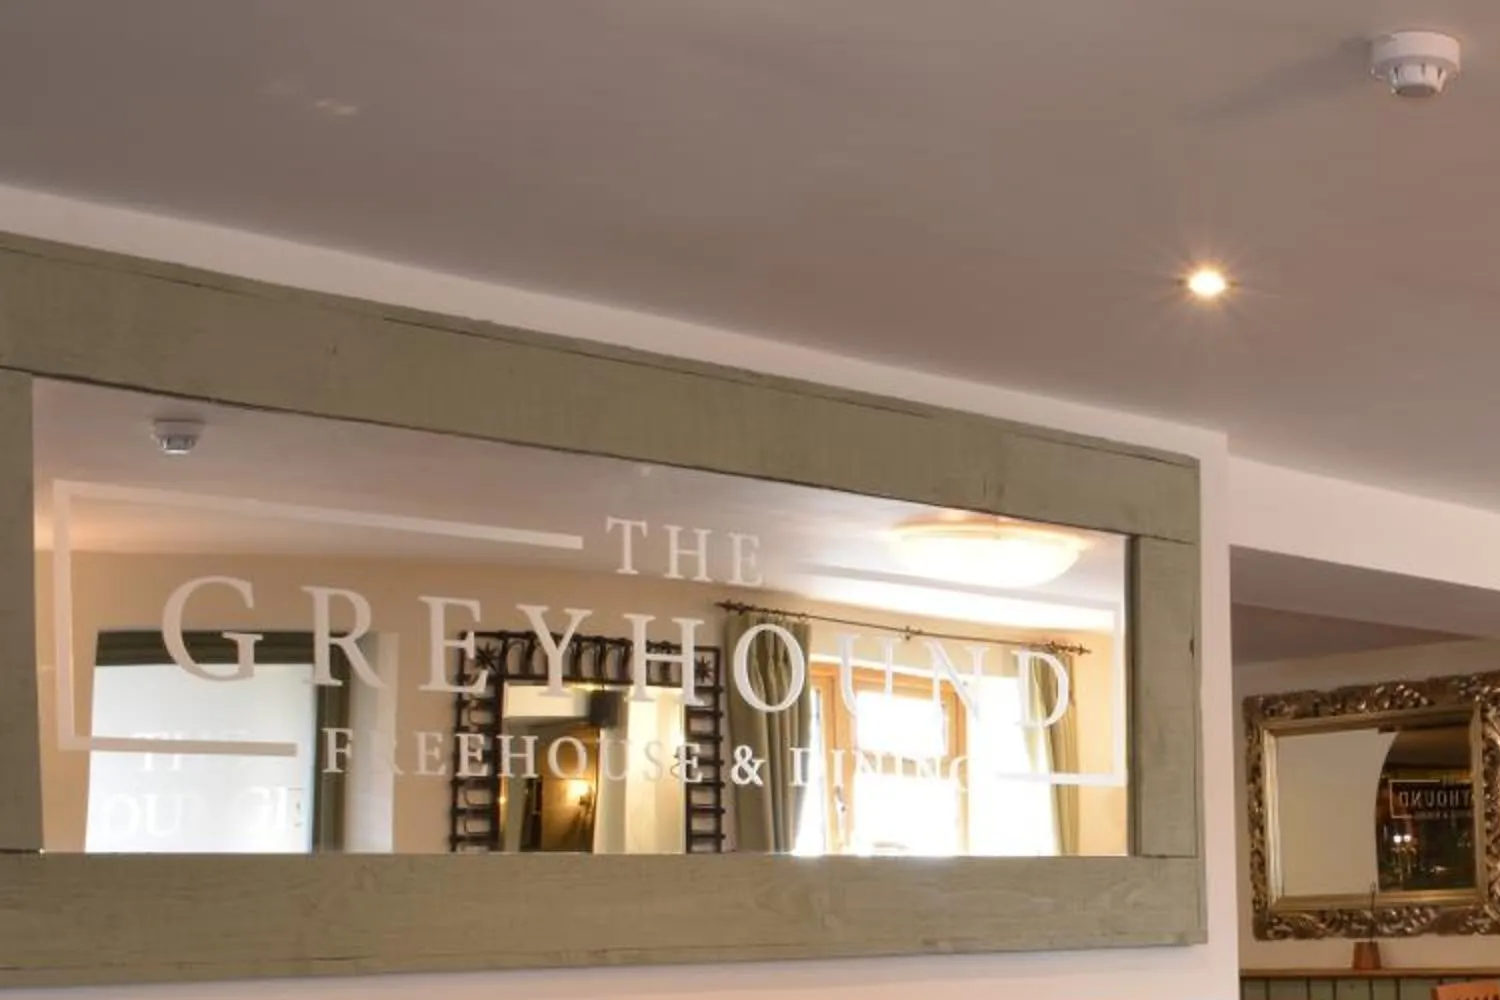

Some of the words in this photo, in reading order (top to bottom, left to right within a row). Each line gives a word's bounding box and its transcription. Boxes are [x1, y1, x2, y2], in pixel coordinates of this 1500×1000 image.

[606, 516, 764, 587] THE
[161, 575, 1070, 729] GREYHOUND
[321, 726, 703, 784] FREEHOUSE
[730, 744, 767, 787] &
